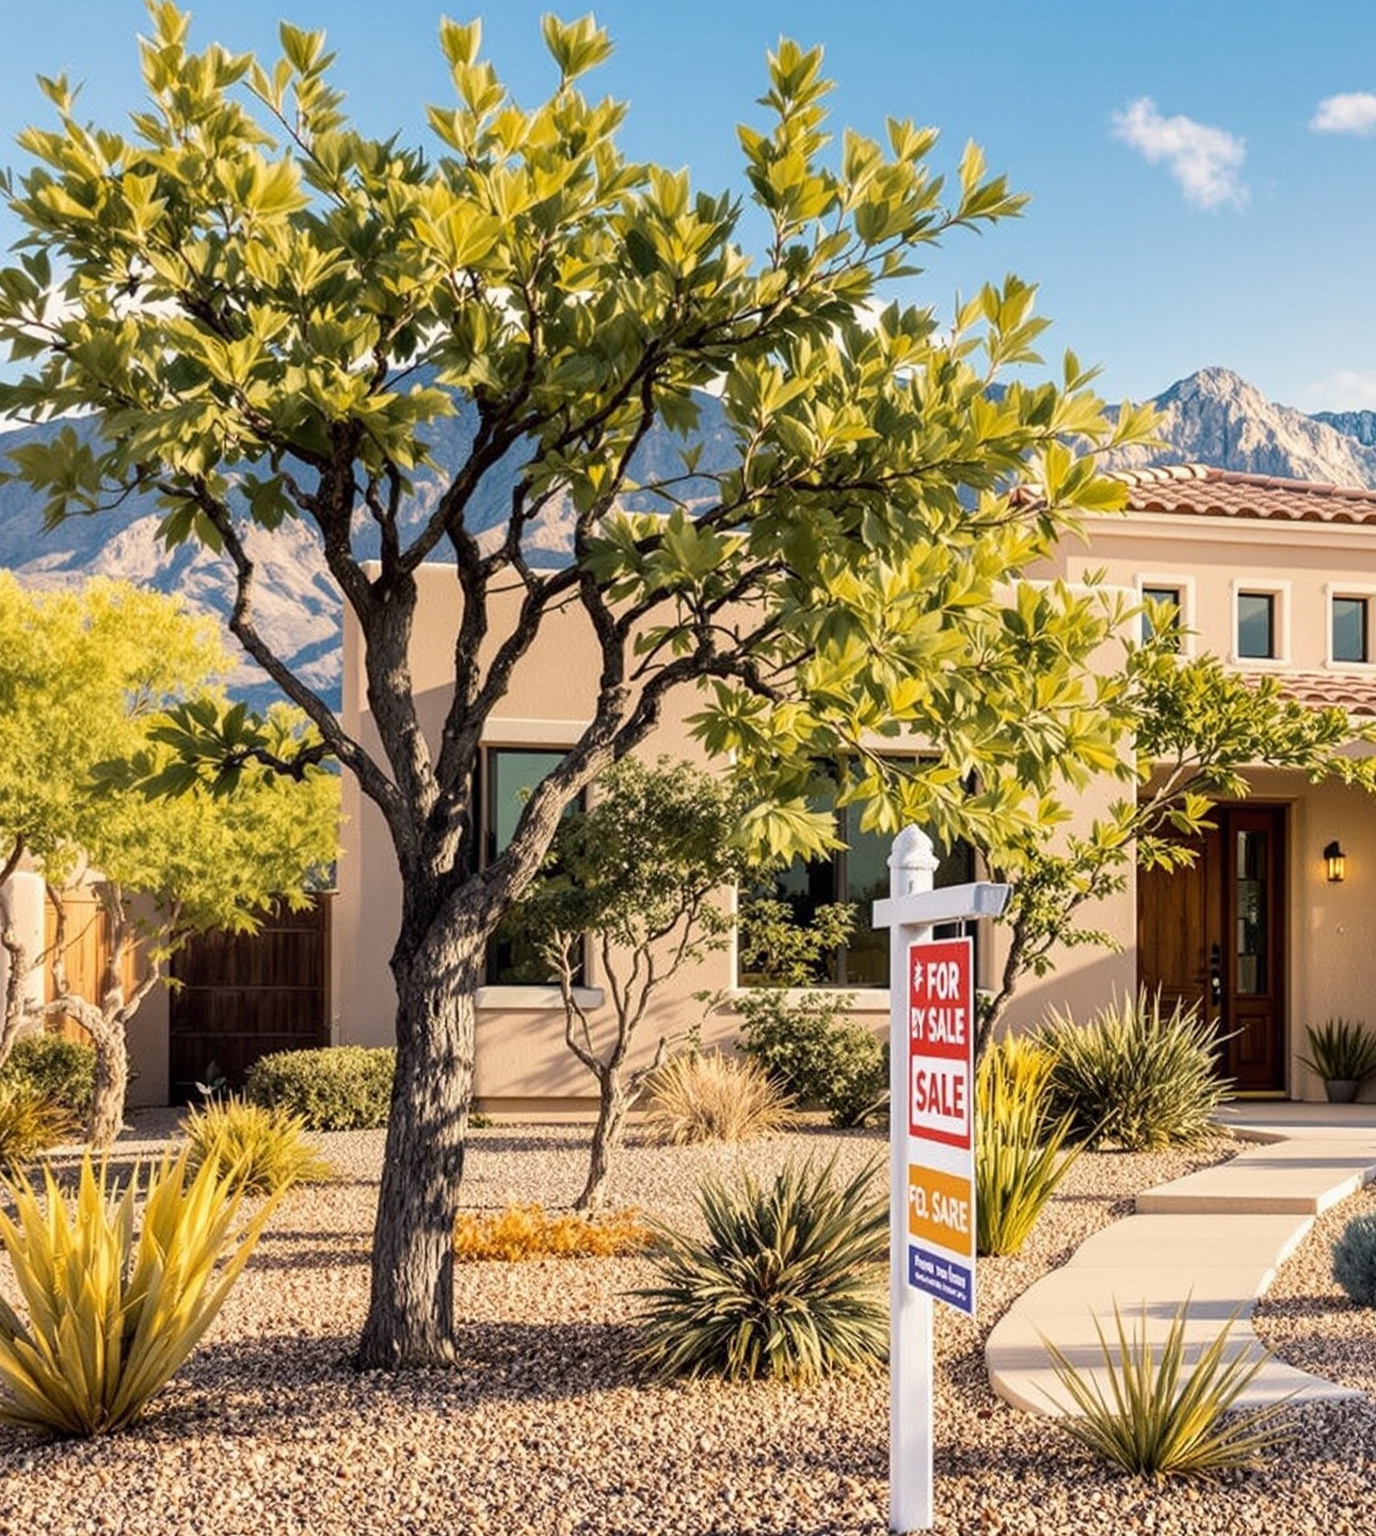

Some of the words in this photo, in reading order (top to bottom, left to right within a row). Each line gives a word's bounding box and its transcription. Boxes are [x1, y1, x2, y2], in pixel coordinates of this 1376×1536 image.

[926, 961, 960, 1000] FOR
[927, 1006, 965, 1045] SALE
[916, 1069, 964, 1119] SALE
[932, 1191, 969, 1233] SARE
